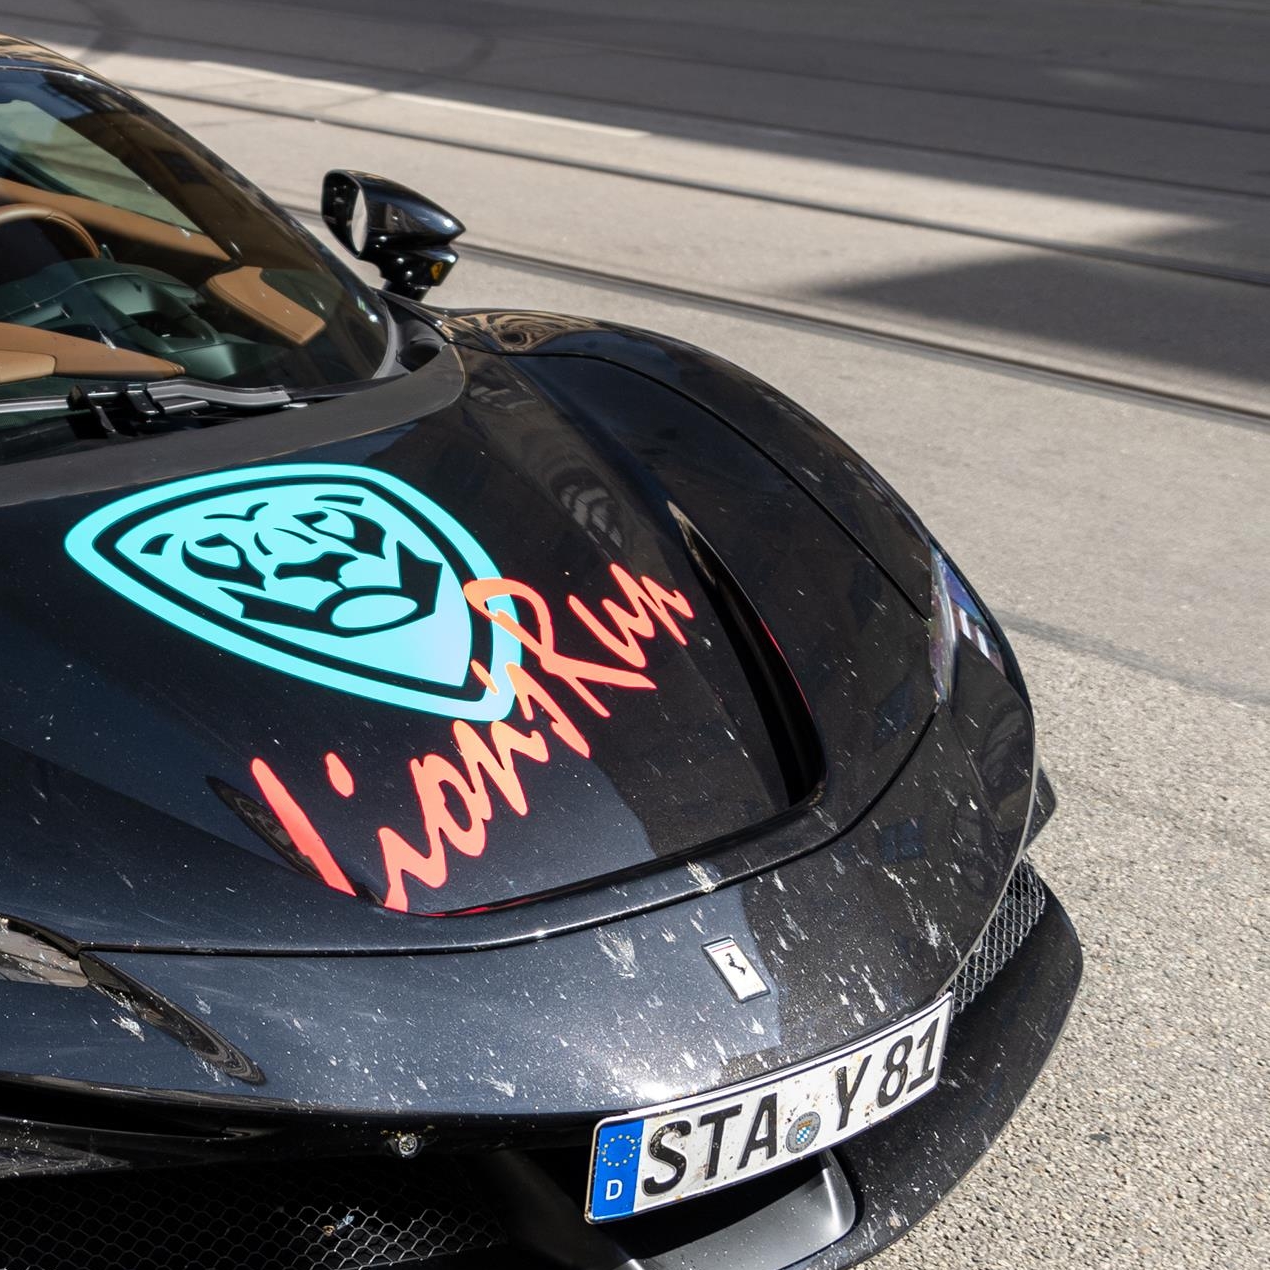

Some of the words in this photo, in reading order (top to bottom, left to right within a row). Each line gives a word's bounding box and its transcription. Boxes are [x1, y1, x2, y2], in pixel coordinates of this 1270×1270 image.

[642, 1091, 778, 1197] STA
[836, 1055, 872, 1131] Y
[877, 1017, 940, 1108] 81
[605, 1179, 623, 1201] D
